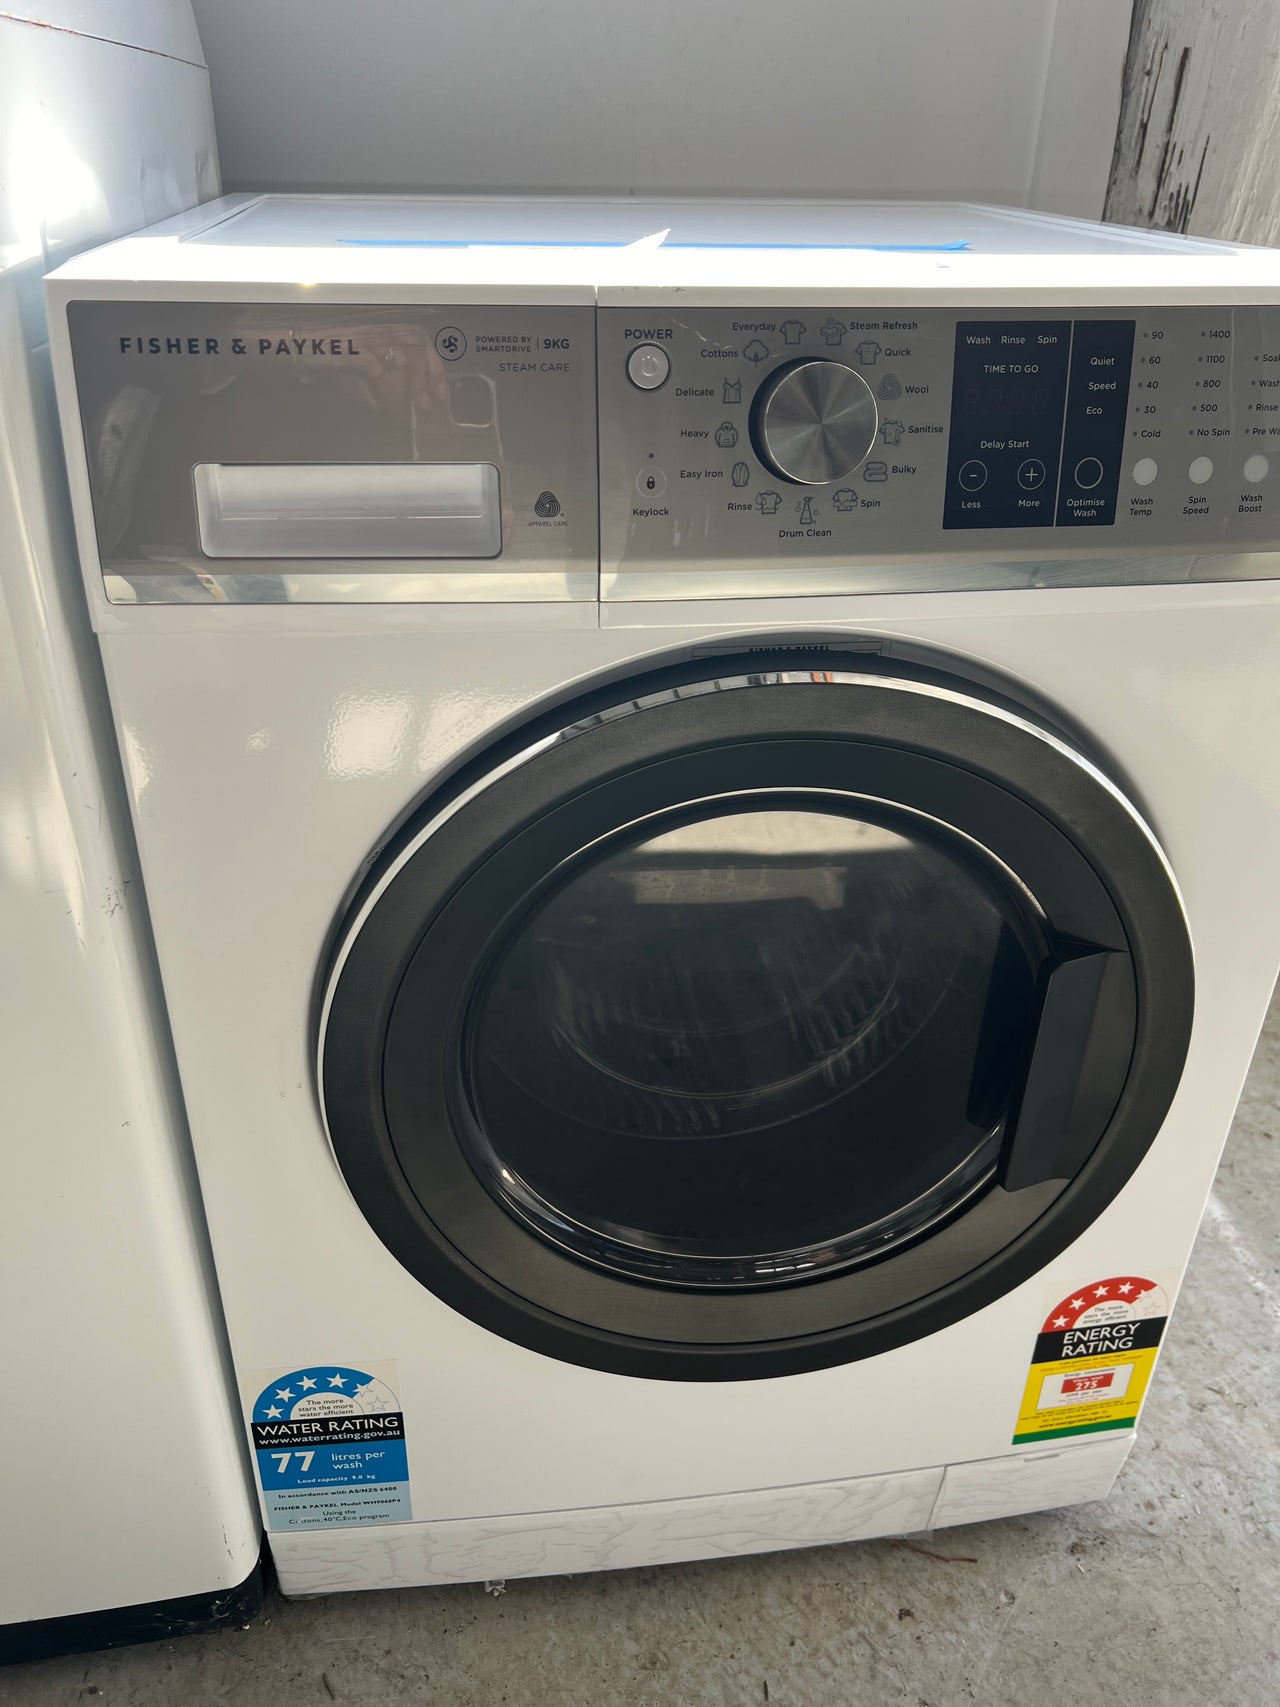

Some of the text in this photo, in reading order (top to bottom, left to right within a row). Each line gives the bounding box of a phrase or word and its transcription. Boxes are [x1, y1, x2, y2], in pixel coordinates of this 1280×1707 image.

[732, 322, 776, 332] Everyday
[850, 321, 918, 330] Steam Refresh
[624, 329, 673, 339] POWER
[1151, 331, 1164, 340] 90
[1208, 330, 1231, 339] 1400
[475, 335, 532, 344] POWERED BY
[543, 338, 570, 350] 9KG
[966, 335, 1057, 345] Wash Rinse Spin
[119, 336, 360, 356] FISHER & PAYKEL
[475, 344, 532, 353] SMARTDRIVE
[701, 349, 738, 358] Cottons
[885, 348, 911, 357] Quick
[1090, 357, 1115, 366] Quiet
[1149, 356, 1161, 365] 60
[1205, 355, 1225, 363] 1100
[499, 363, 570, 372] STEAM CARE
[984, 365, 1006, 373] TIME
[1024, 365, 1039, 373] GO
[1088, 382, 1116, 391] Speed
[1146, 381, 1159, 389] 40
[1203, 379, 1221, 388] 800
[675, 388, 714, 396] Delicate
[905, 385, 929, 394] Wool
[1086, 407, 1103, 415] Eco
[1144, 406, 1156, 414] 30
[1200, 404, 1218, 412] 500
[680, 429, 709, 439] Heavy
[908, 425, 944, 434] Sanitise
[1141, 430, 1161, 438] Cold
[1211, 428, 1231, 438] Spin
[980, 440, 1030, 450] Delay Start
[680, 469, 723, 479] Easy Iron
[892, 465, 917, 475] Bulky
[1130, 498, 1153, 506] Wash
[1188, 496, 1207, 506] Spin
[1240, 494, 1263, 502] Wash
[727, 502, 753, 511] Rinse
[860, 499, 881, 509] Spin
[961, 500, 981, 509] Less
[1018, 499, 1040, 507] More
[1066, 498, 1105, 508] Optimise
[632, 507, 669, 517] Keylock
[1073, 509, 1097, 517] Wash
[1129, 508, 1152, 517] Temp
[1182, 506, 1209, 516] Speed
[1238, 505, 1262, 513] Boost
[779, 528, 832, 538] Drum Clean
[1063, 1322, 1141, 1344] ENERGY
[1062, 1337, 1133, 1357] RATING
[1075, 1380, 1098, 1391] 275
[257, 1417, 398, 1436] WATER RATING
[259, 1430, 400, 1445] www.waterrating.gov.au
[332, 1452, 385, 1461] litres per
[271, 1451, 315, 1473] 77
[333, 1461, 362, 1469] wash
[359, 1513, 389, 1521] program
